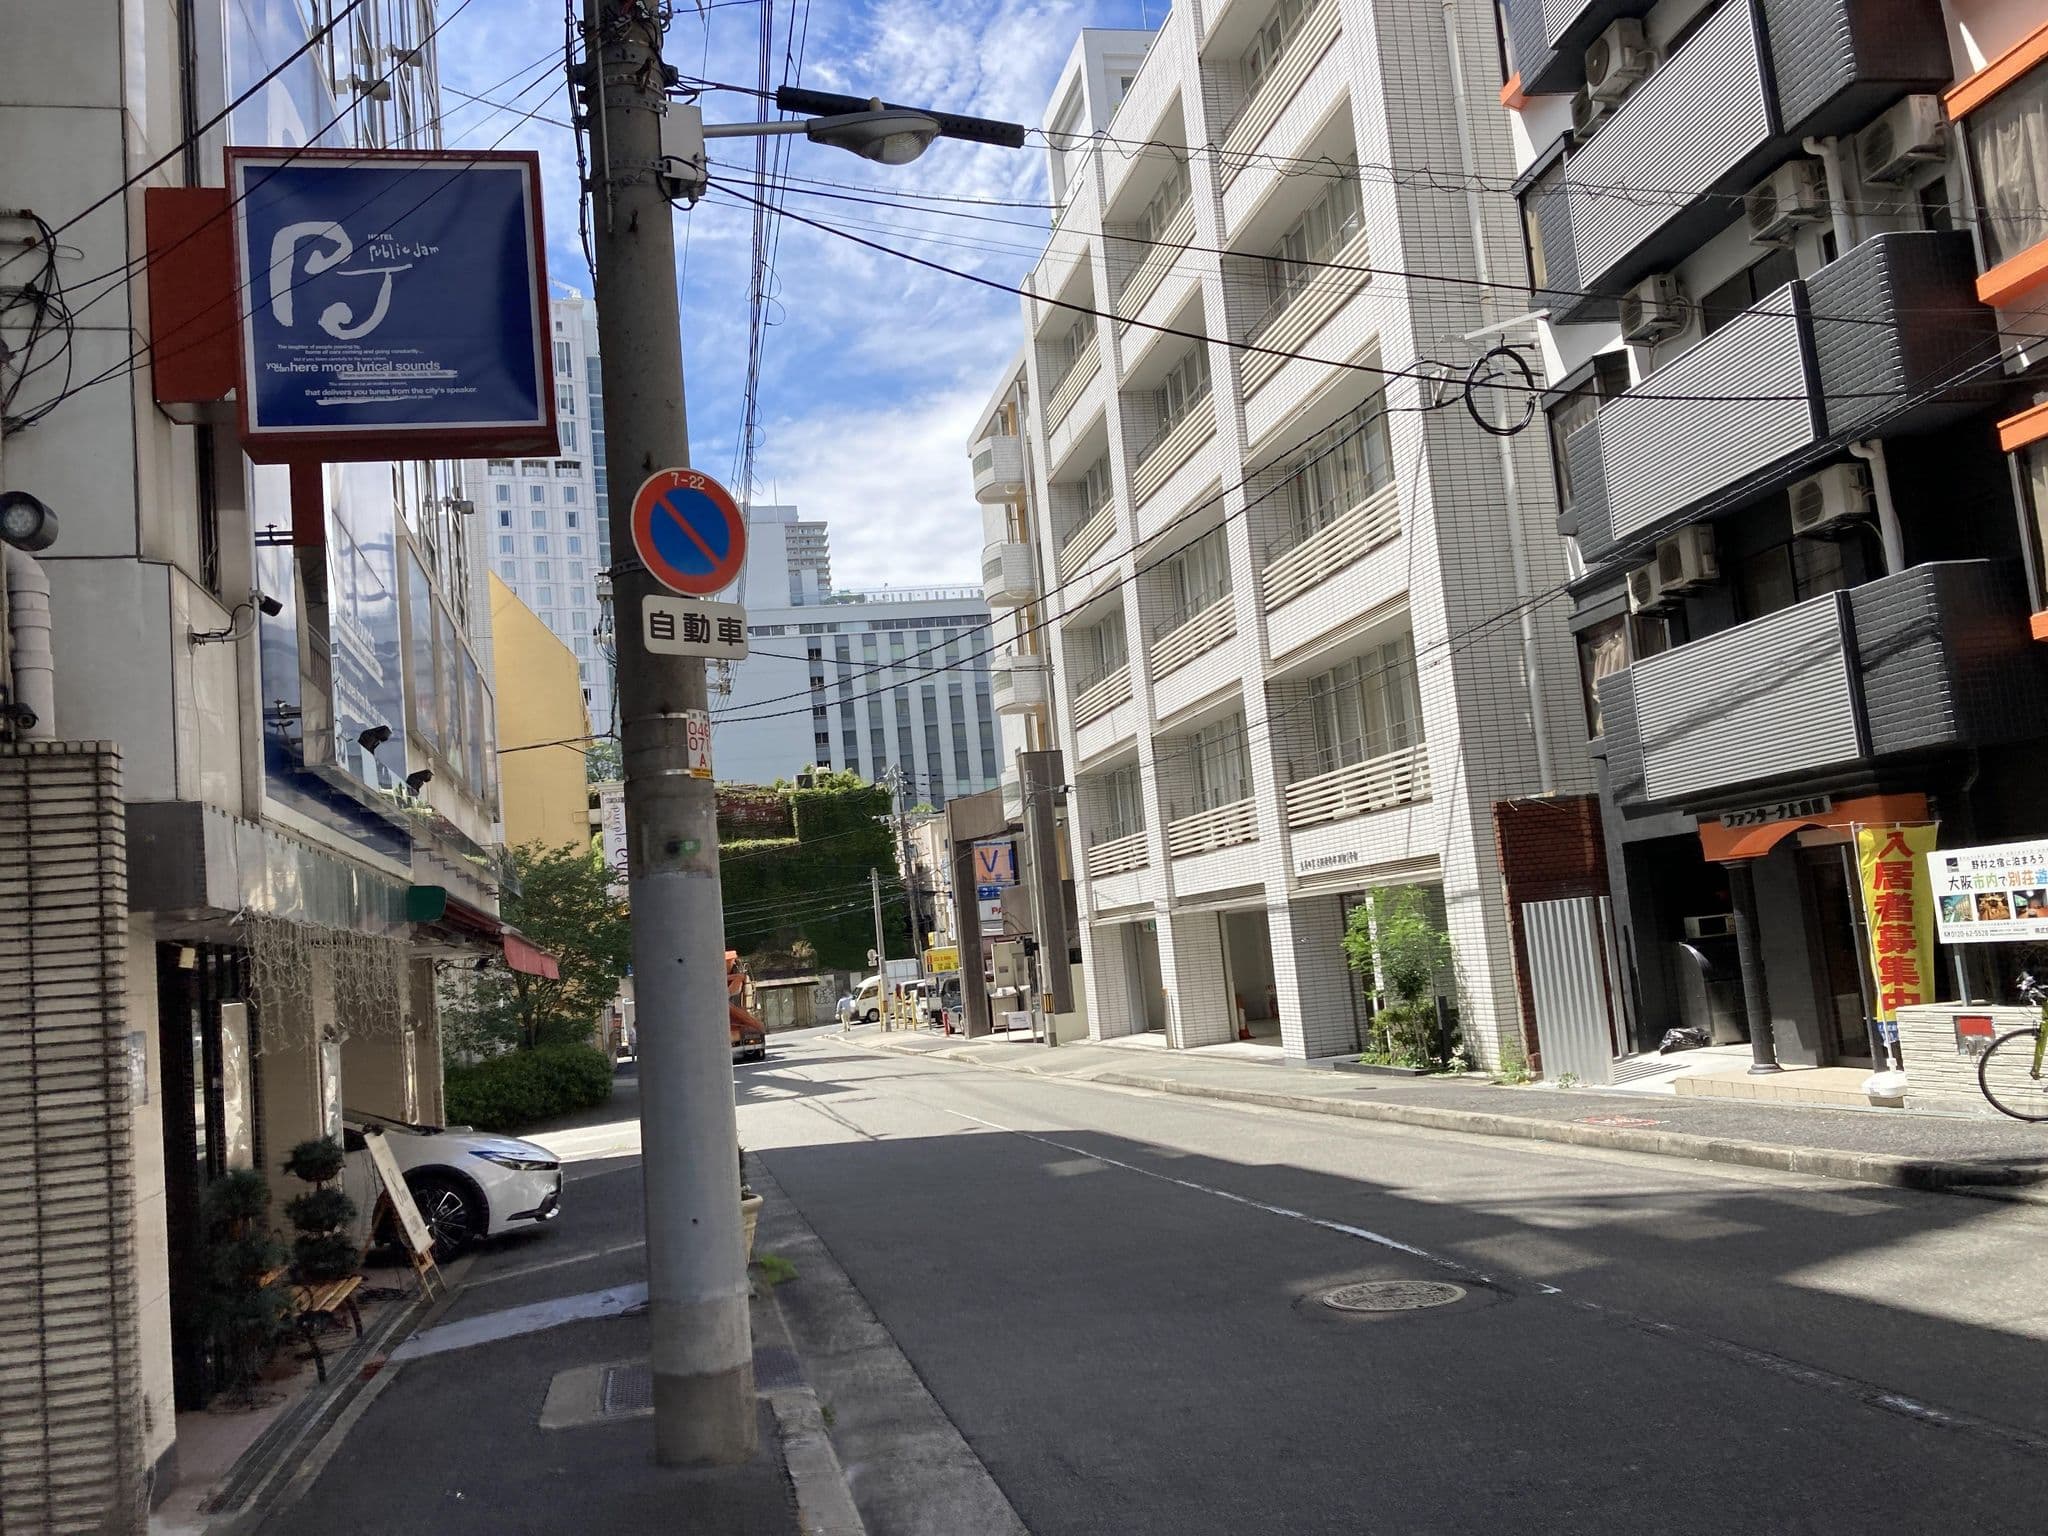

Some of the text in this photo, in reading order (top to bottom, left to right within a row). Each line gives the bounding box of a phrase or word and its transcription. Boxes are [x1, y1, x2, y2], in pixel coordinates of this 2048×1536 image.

[290, 361, 318, 372] here
[321, 362, 354, 372] more
[356, 361, 393, 373] lyrical
[395, 360, 441, 372] sounds
[321, 388, 352, 396] delivers
[353, 389, 368, 397] you
[369, 388, 390, 396] tunes
[391, 388, 410, 396] from
[411, 387, 424, 395] the
[425, 387, 445, 396] city's
[670, 472, 705, 490] 7-22
[650, 610, 744, 646] 自動車
[699, 752, 707, 768] A
[1873, 830, 1920, 1011] 入居者募集中
